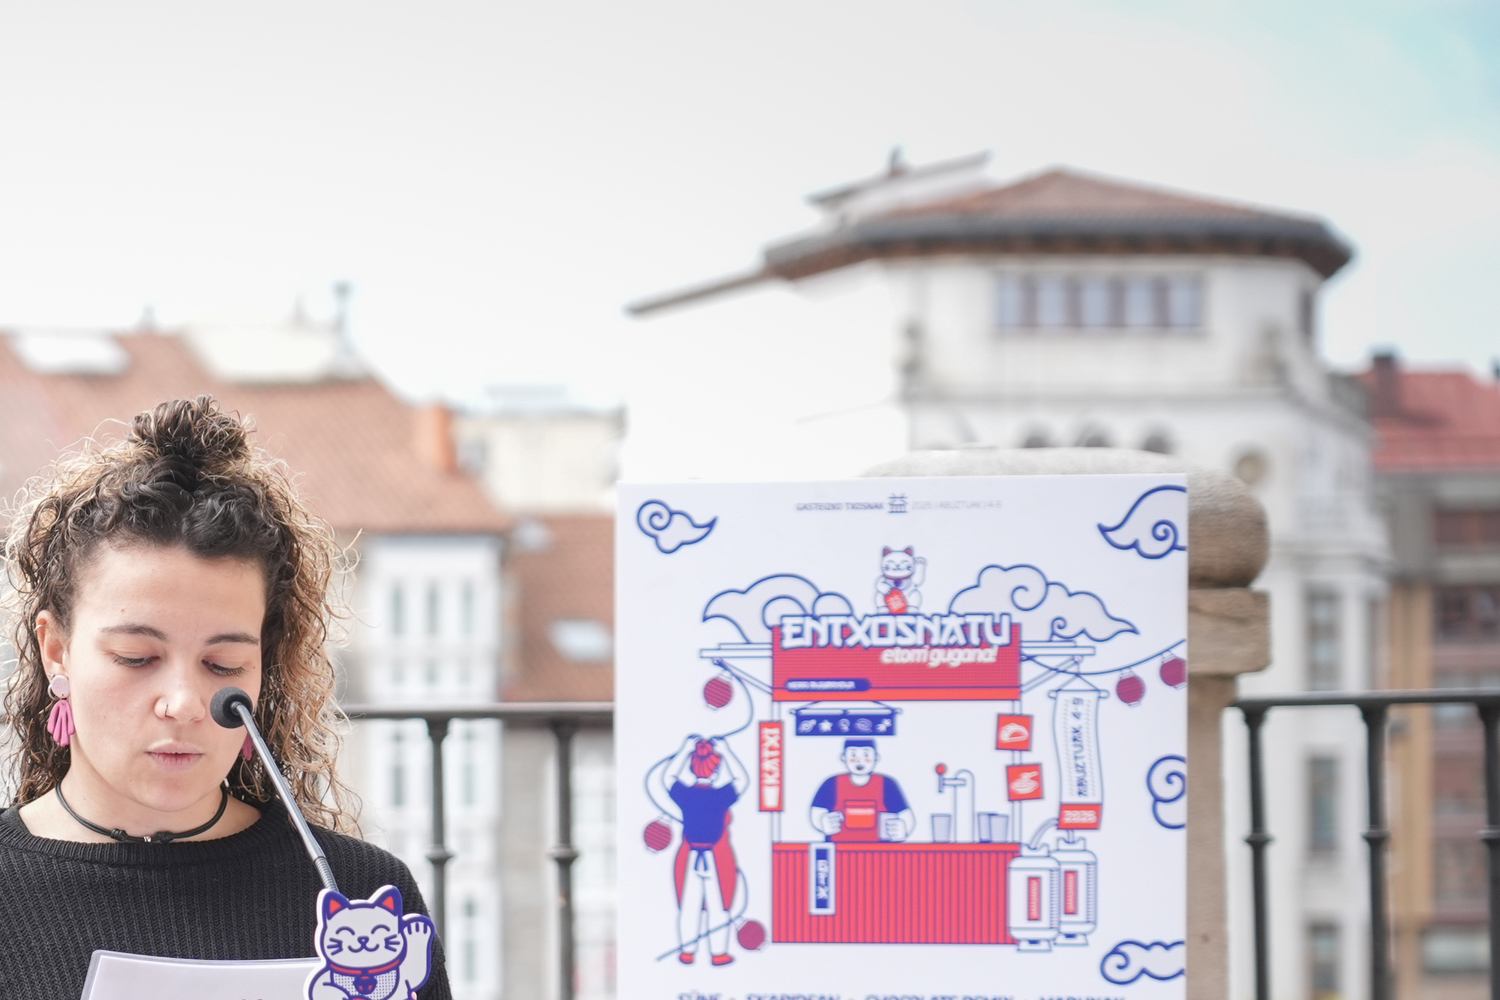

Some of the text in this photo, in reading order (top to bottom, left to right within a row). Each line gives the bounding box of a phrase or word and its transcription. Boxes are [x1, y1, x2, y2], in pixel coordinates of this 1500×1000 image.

[782, 614, 1011, 649] ENTXOSNATU
[880, 645, 999, 667] etorri gugana!
[1071, 725, 1088, 797] ABUZTUAK
